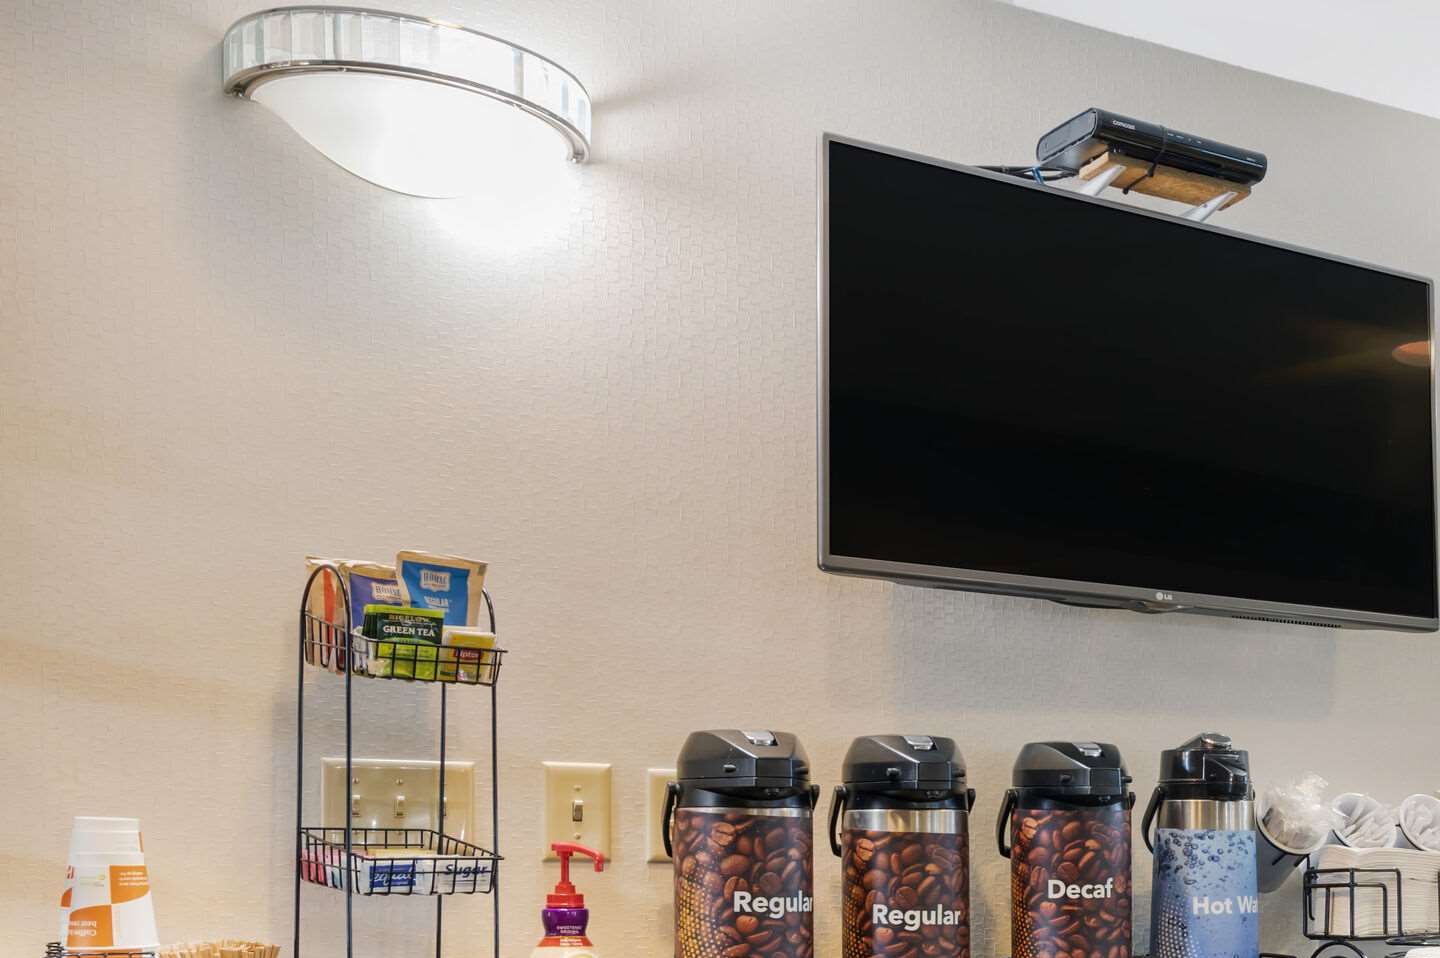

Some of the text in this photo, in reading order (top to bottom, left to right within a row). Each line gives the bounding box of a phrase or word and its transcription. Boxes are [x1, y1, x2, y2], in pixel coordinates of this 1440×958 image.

[383, 625, 436, 638] GREEN TEA
[445, 863, 488, 878] Sugar
[1047, 878, 1114, 900] Decaf
[733, 890, 813, 919] Regular
[1192, 895, 1259, 915] Hot Wa
[872, 904, 961, 931] Regular
